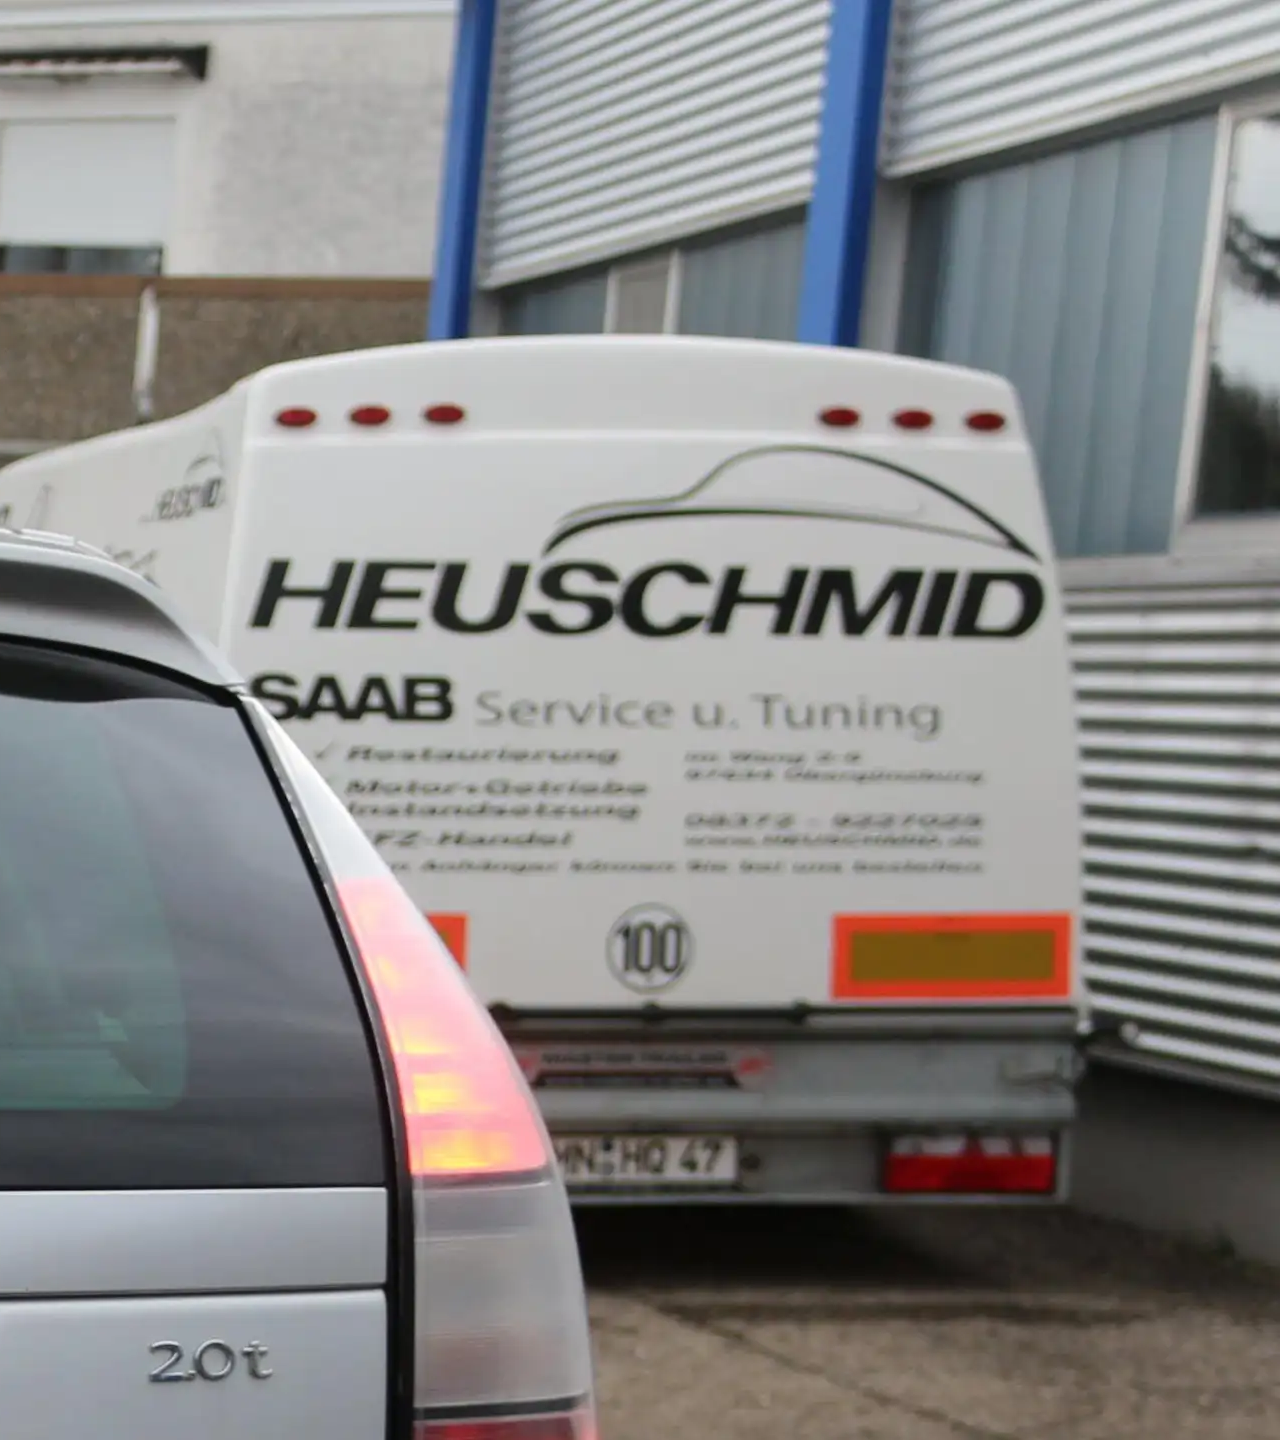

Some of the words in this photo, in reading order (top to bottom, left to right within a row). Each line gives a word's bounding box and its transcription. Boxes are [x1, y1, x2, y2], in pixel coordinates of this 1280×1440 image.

[250, 558, 1045, 639] HEUSCHMID
[249, 674, 454, 722] SAAB
[475, 690, 675, 729] Service
[692, 702, 740, 729] u.
[752, 692, 944, 742] Tuning
[345, 745, 621, 766] Restaurierung
[615, 921, 683, 974] 100
[619, 1136, 667, 1174] HQ
[679, 1136, 724, 1174] 47
